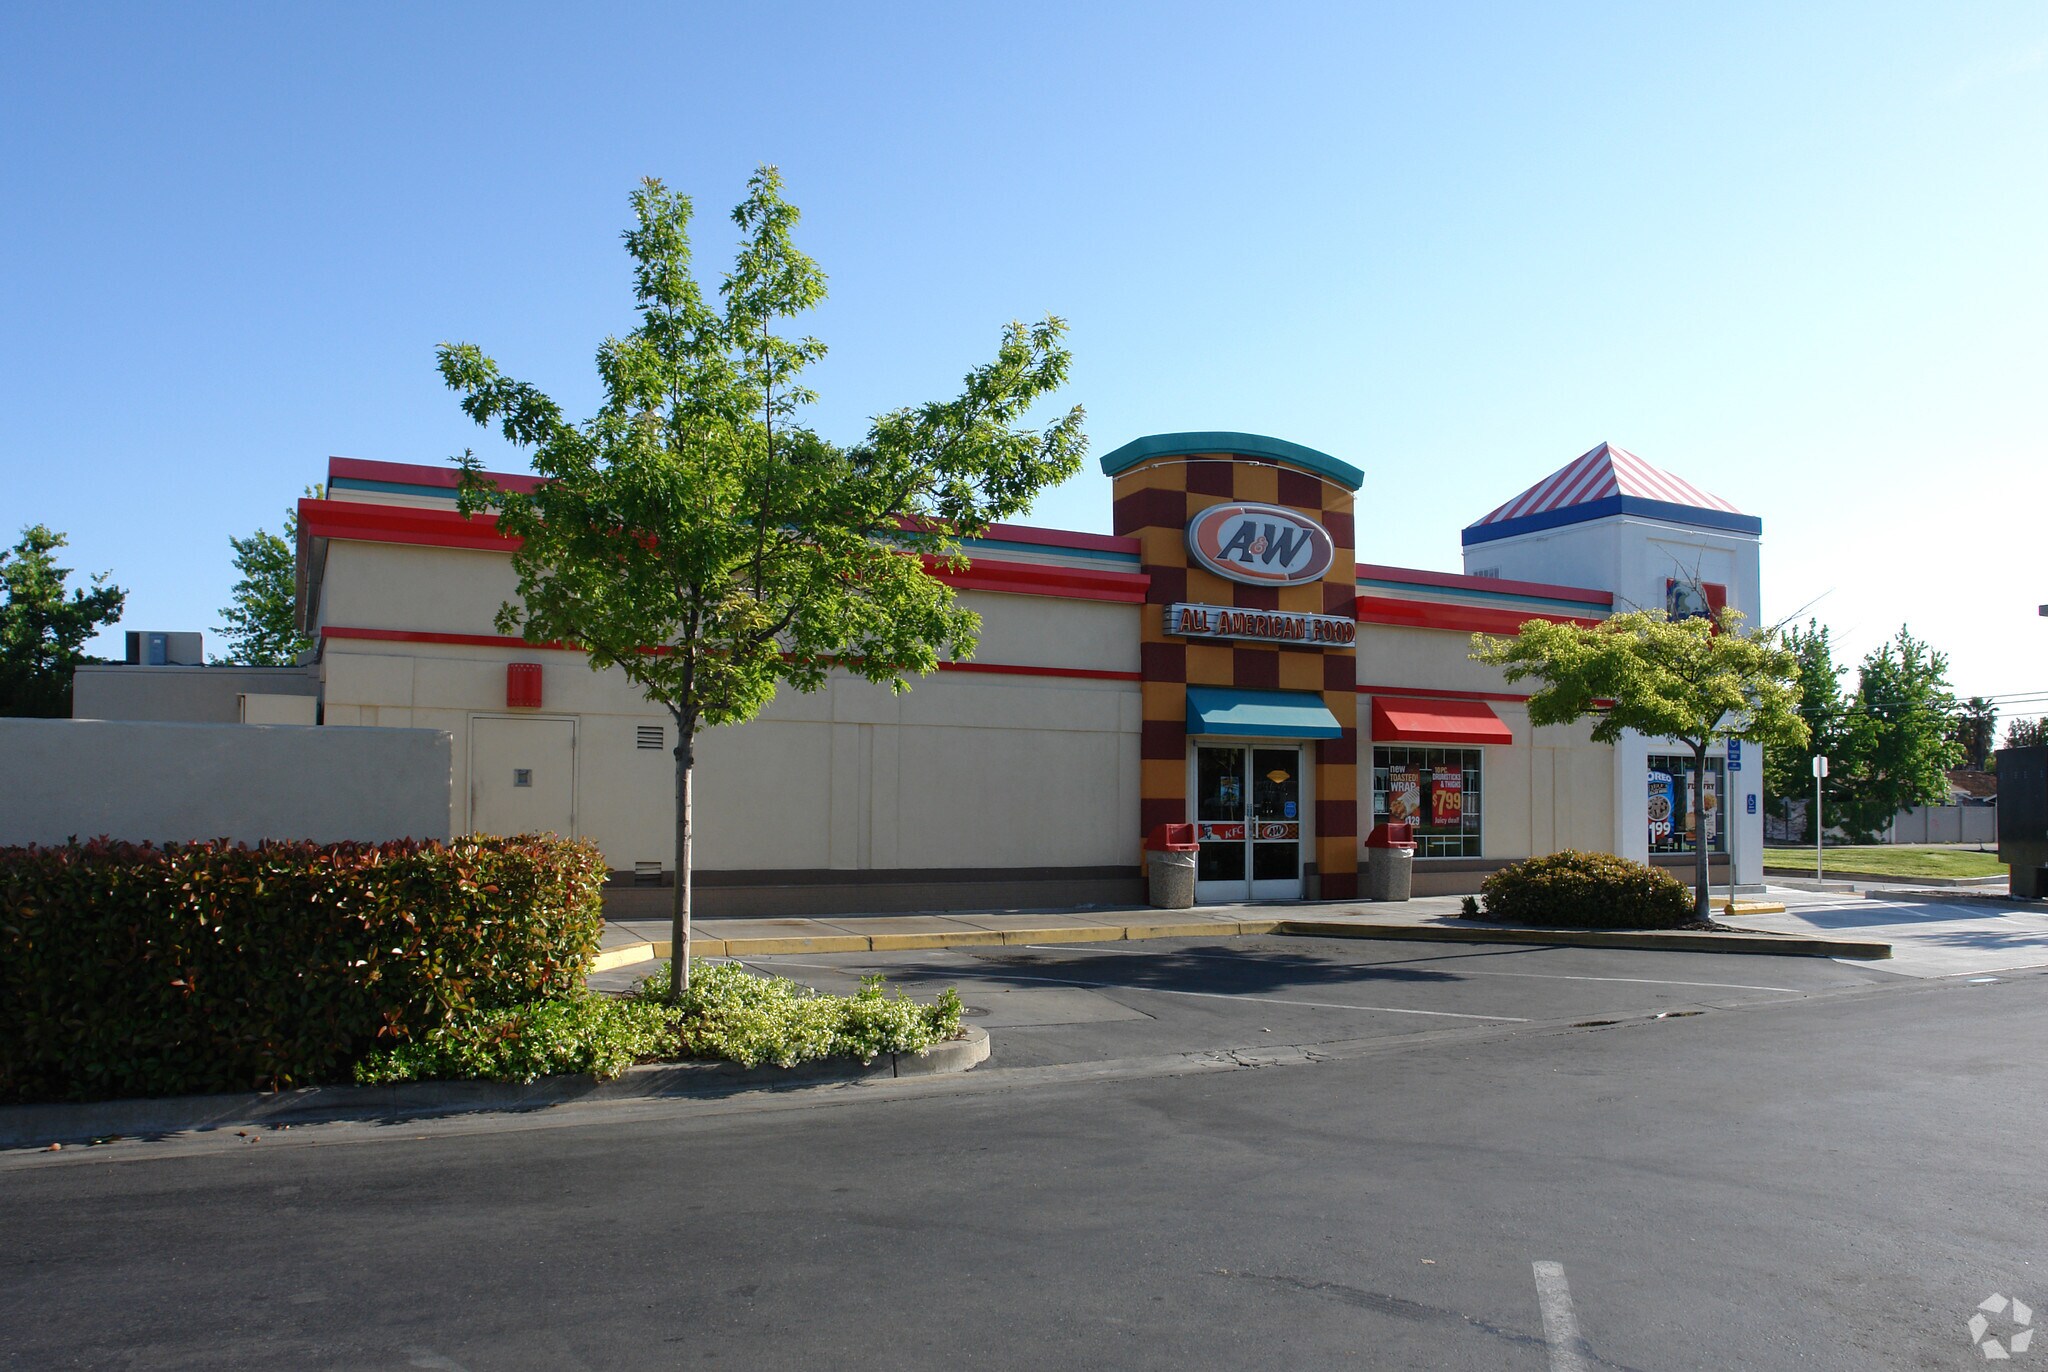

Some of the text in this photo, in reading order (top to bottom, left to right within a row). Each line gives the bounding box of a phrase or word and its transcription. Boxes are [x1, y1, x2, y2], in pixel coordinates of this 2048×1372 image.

[1215, 520, 1314, 568] A&W
[1179, 607, 1356, 645] ALL AMERICAN FOOD
[1647, 771, 1672, 782] OREO
[1391, 782, 1416, 791] WRAP
[1225, 825, 1243, 839] KFC
